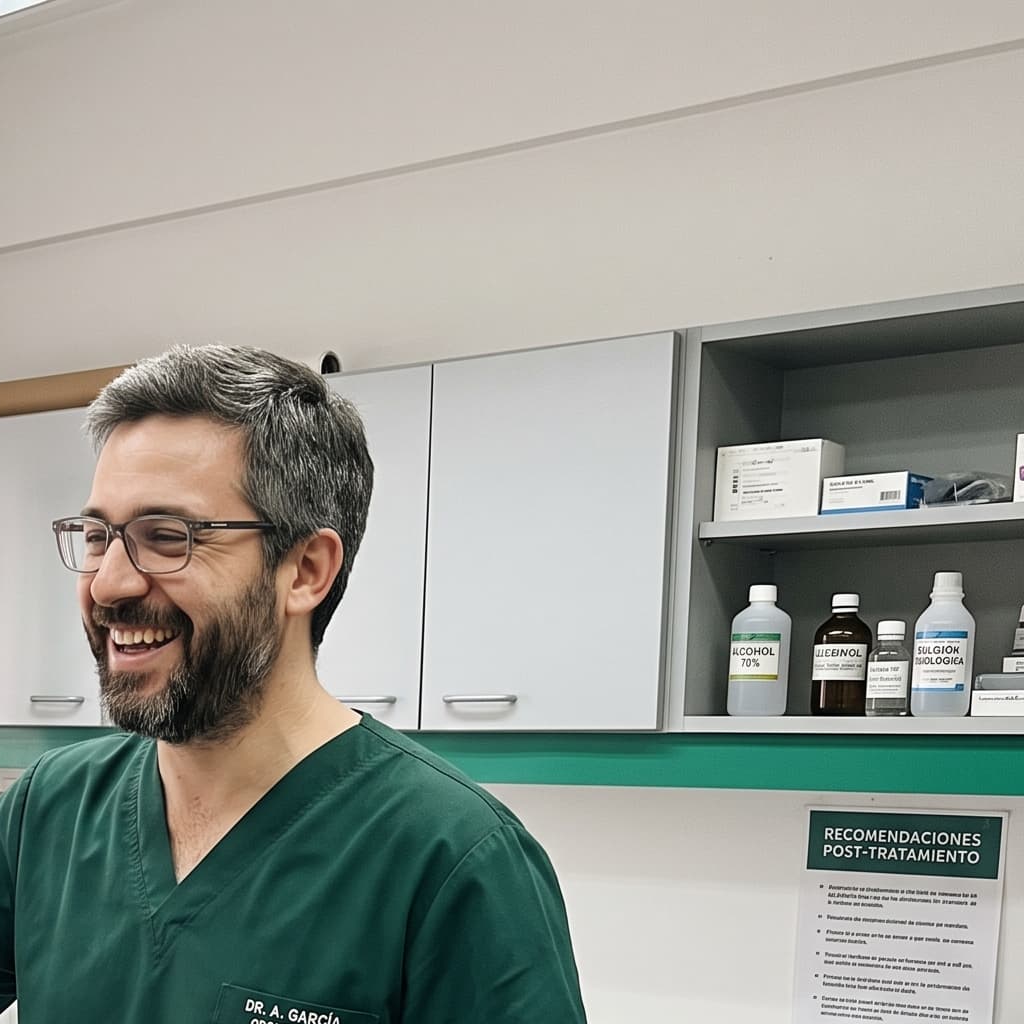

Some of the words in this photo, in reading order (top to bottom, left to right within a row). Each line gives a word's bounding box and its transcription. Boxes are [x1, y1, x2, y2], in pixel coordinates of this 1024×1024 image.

[741, 658, 760, 668] 70%
[824, 827, 982, 847] RECOMENDACIONES
[823, 844, 980, 864] POST-TRATAMIENTO
[245, 999, 266, 1016] DR.
[269, 1005, 284, 1019] A.
